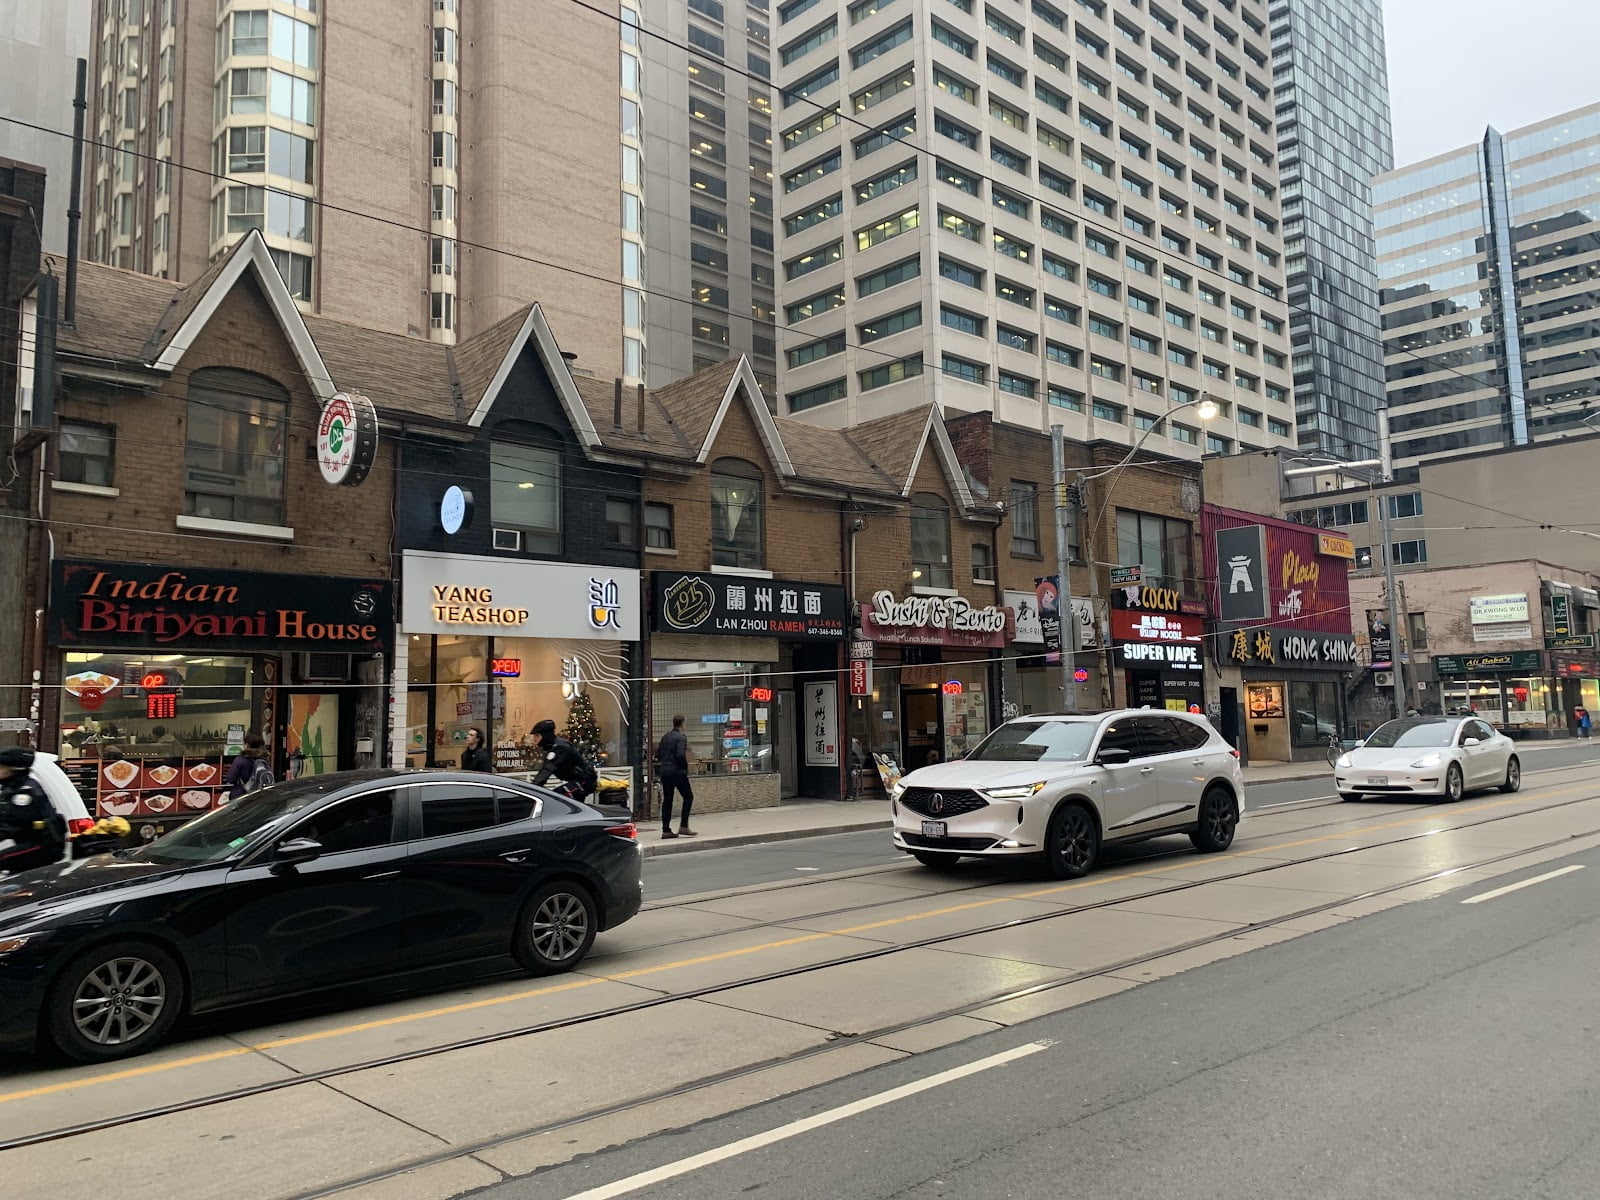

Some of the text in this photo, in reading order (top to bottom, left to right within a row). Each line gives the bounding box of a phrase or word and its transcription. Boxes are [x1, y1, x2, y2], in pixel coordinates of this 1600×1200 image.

[81, 571, 240, 604] Indian
[434, 585, 493, 604] YANG
[673, 579, 704, 616] 1915
[1141, 586, 1179, 611] COCKY
[434, 606, 529, 624] TEASHOP
[870, 590, 1006, 632] Sushi & Bento
[78, 599, 377, 642] Biriyani House
[716, 618, 805, 633] LAN ZHOU RAMEN
[861, 641, 872, 649] YOU
[861, 650, 872, 658] EAT
[1123, 643, 1197, 662] SUPER VAPE
[1283, 636, 1357, 662] HONG SHING
[492, 659, 520, 673] OPEN
[854, 661, 863, 694] SUSHI
[746, 688, 771, 701] OPEN
[943, 684, 961, 694] OPEN
[497, 741, 515, 749] VEGAN
[497, 751, 520, 759] OPTIONS
[497, 759, 525, 768] AVAILABLE
